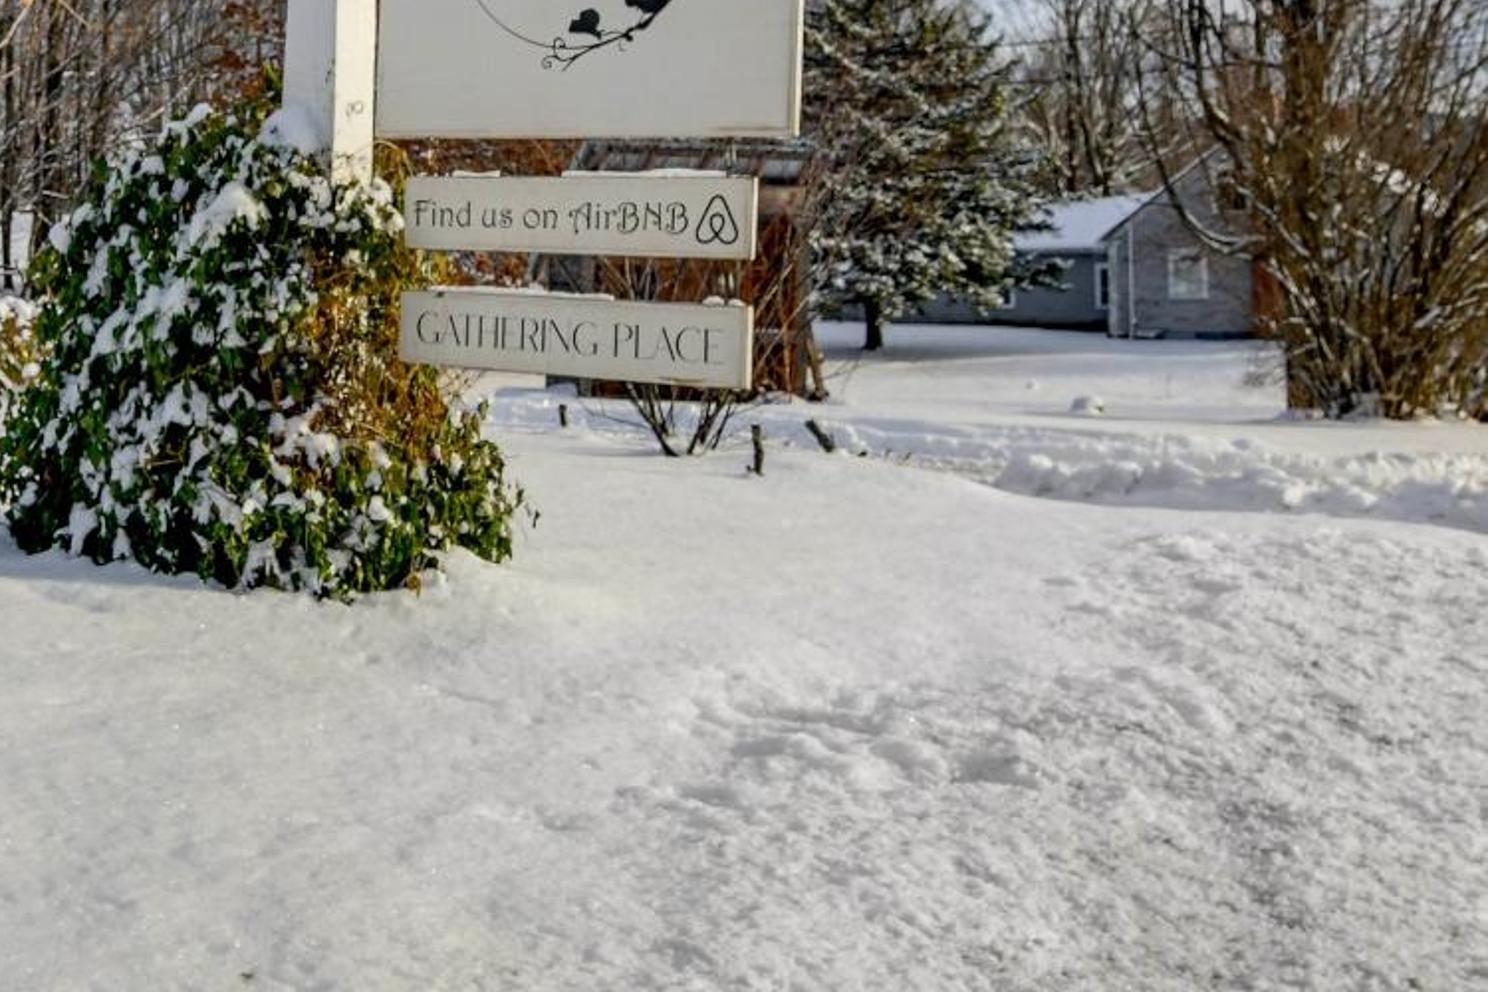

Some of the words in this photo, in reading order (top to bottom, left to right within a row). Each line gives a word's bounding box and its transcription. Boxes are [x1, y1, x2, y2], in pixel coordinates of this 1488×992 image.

[413, 199, 472, 229] Find
[481, 204, 513, 226] us
[522, 207, 559, 229] on
[568, 201, 689, 235] AirBNB
[416, 311, 598, 356] GATHERING
[612, 323, 725, 365] PLACE
